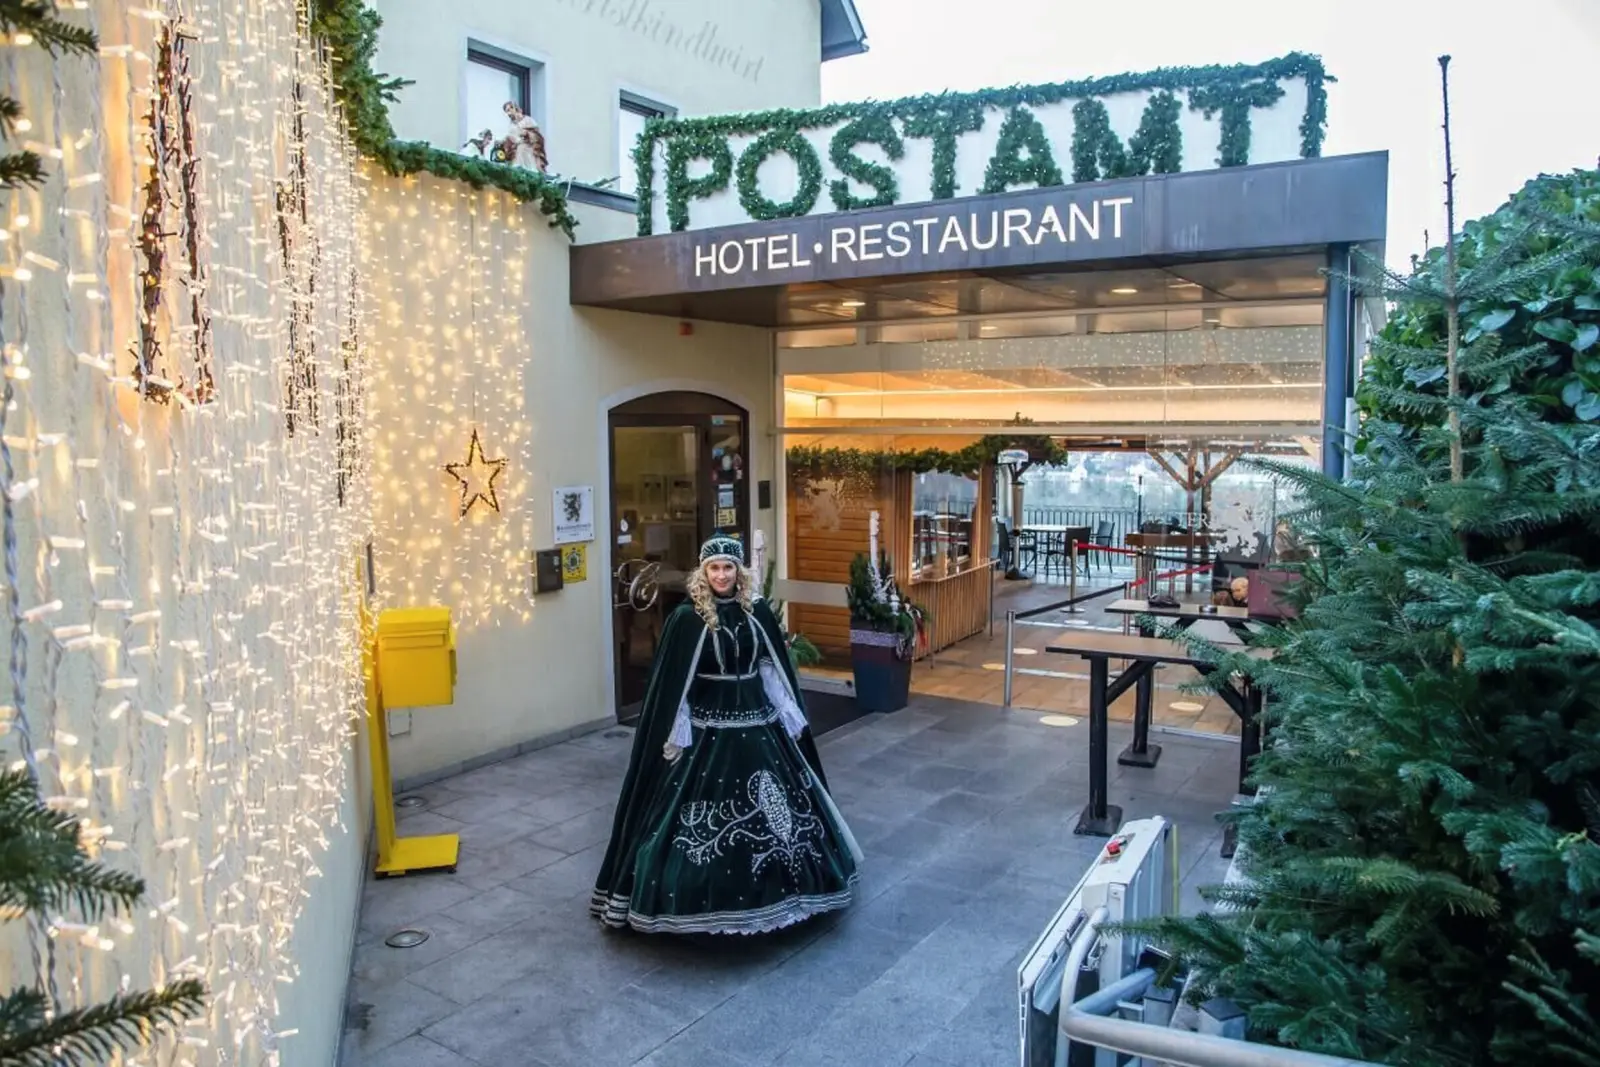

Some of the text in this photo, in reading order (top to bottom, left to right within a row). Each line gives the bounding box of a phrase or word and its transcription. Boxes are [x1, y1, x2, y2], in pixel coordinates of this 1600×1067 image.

[664, 79, 1287, 234] POSTAMT
[694, 197, 1134, 278] HOTEL RESTAURANT
